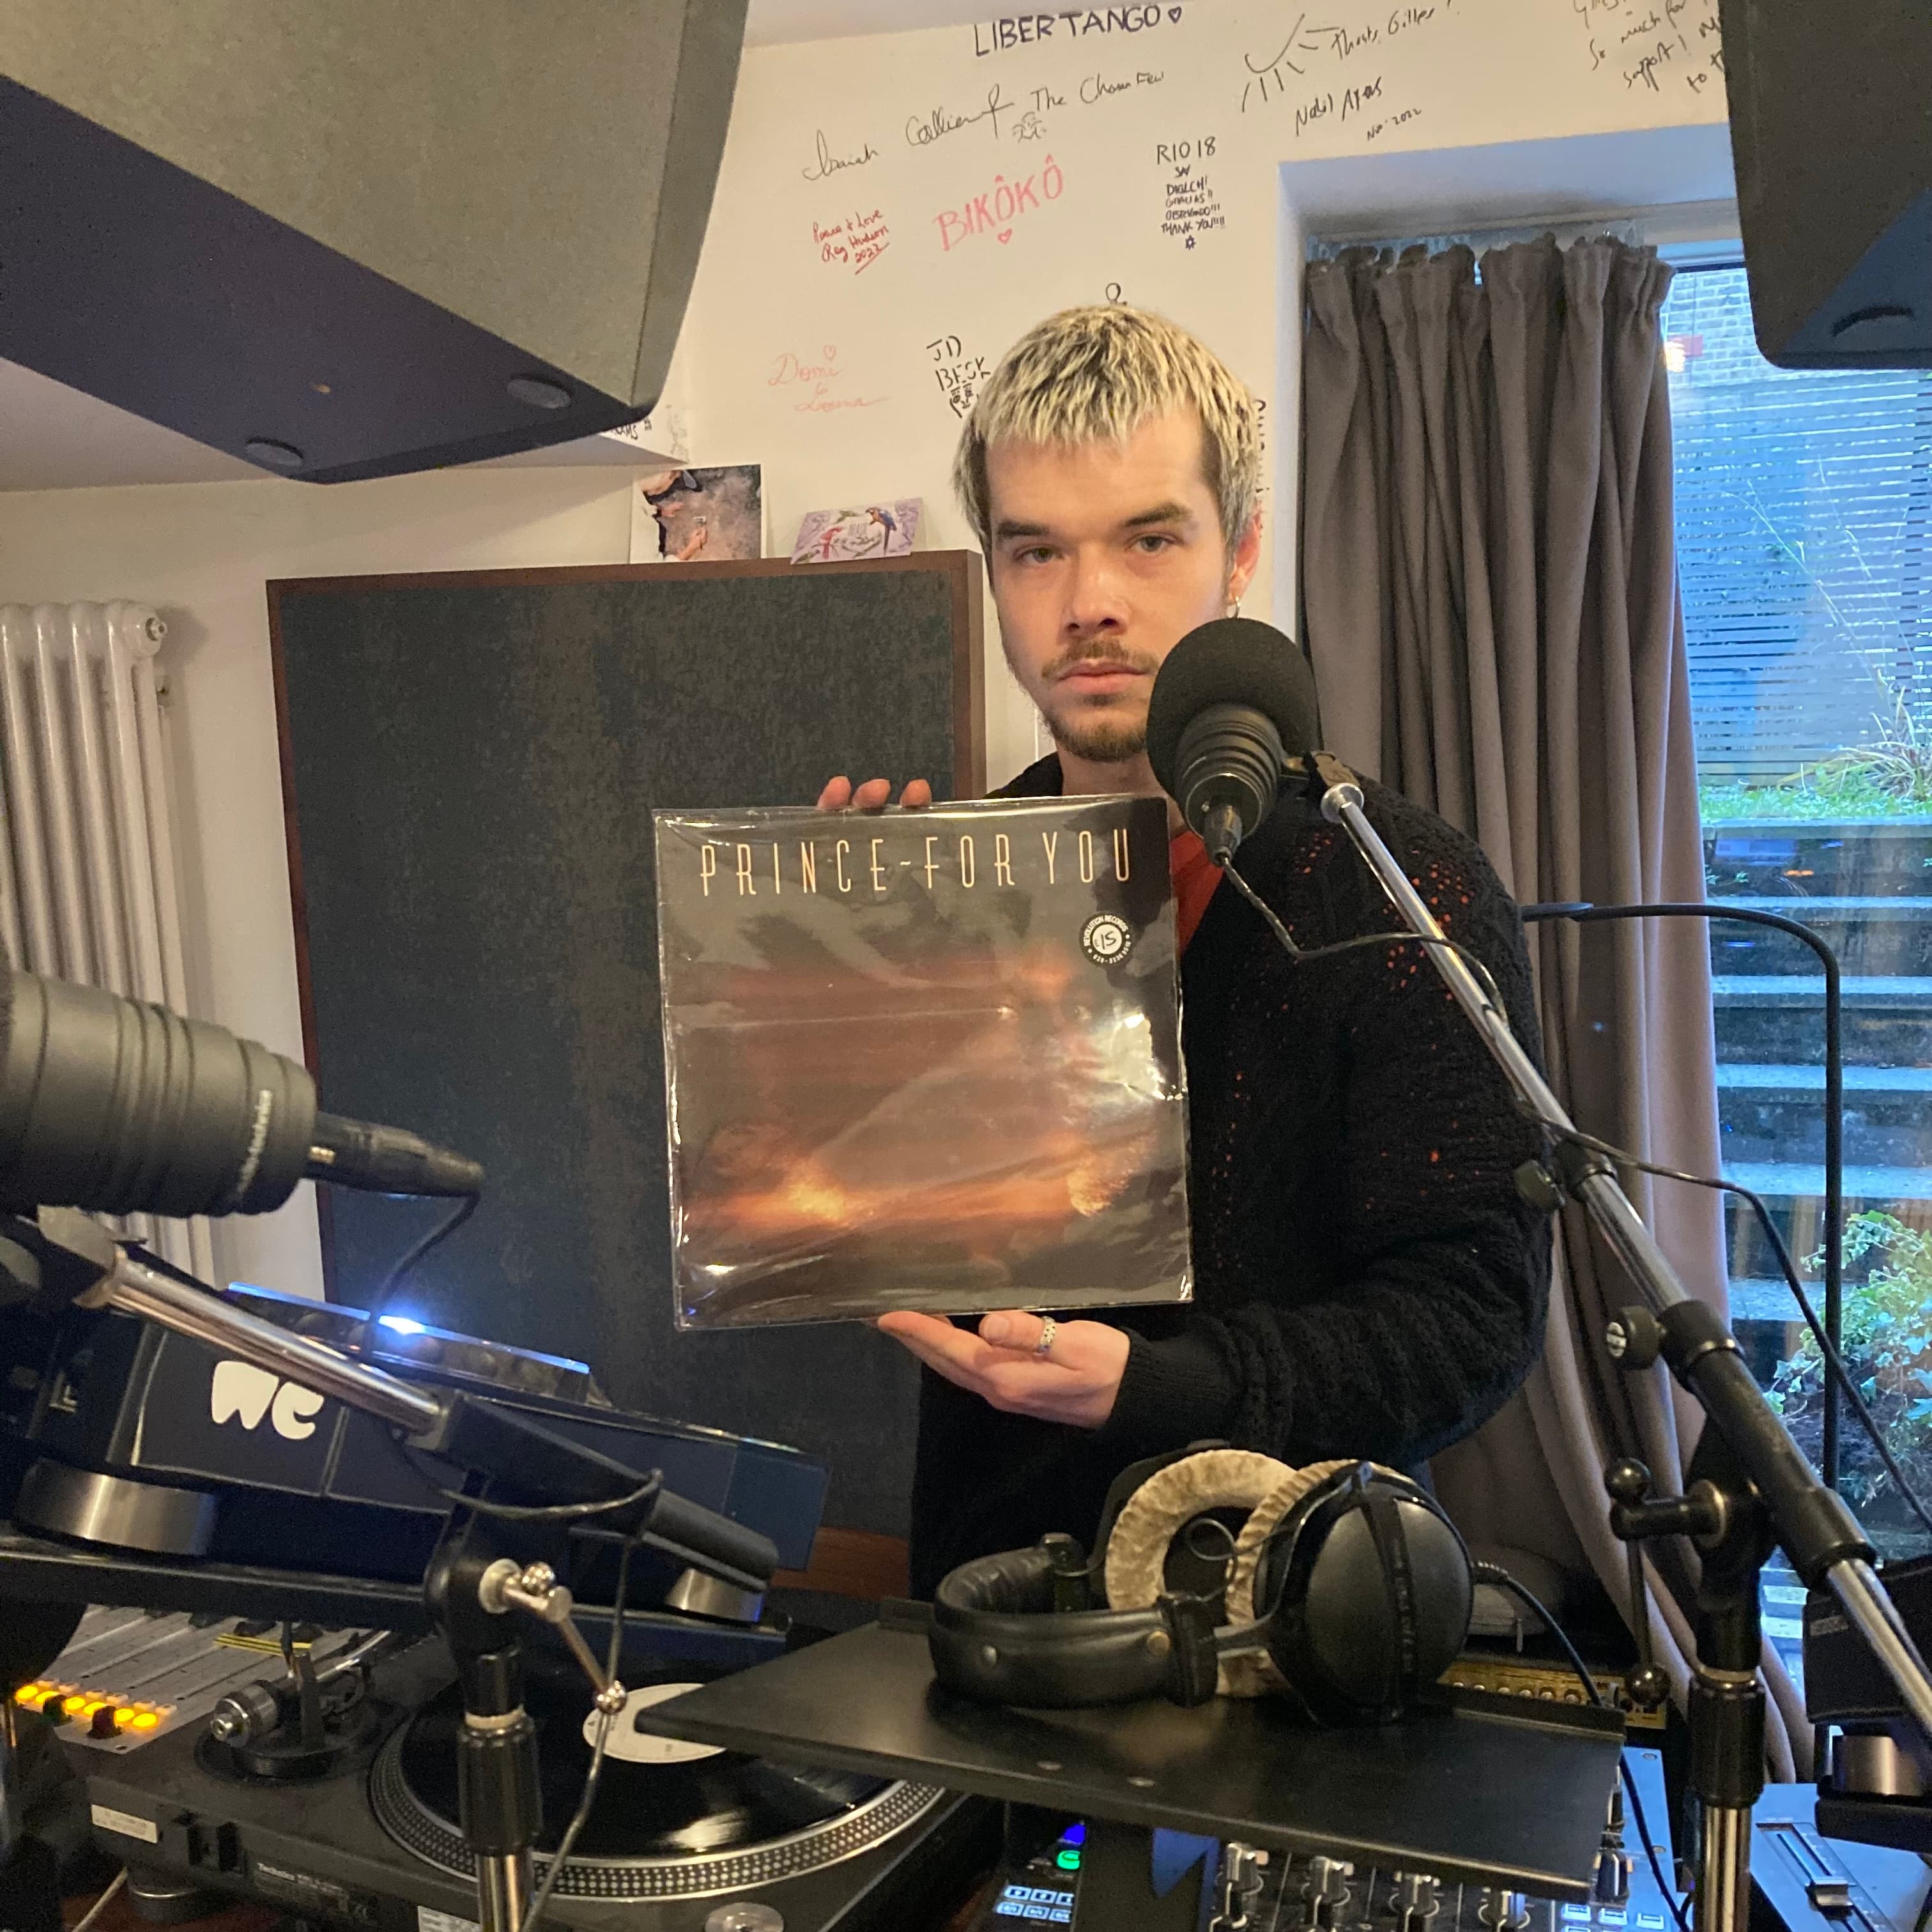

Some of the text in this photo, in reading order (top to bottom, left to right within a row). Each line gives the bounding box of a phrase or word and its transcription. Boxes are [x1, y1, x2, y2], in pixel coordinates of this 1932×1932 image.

[1031, 87, 1067, 111] The
[1157, 136, 1216, 164] RIO 18
[1161, 221, 1193, 235] THANK
[926, 335, 962, 362] JD
[1043, 829, 1130, 884] YOU
